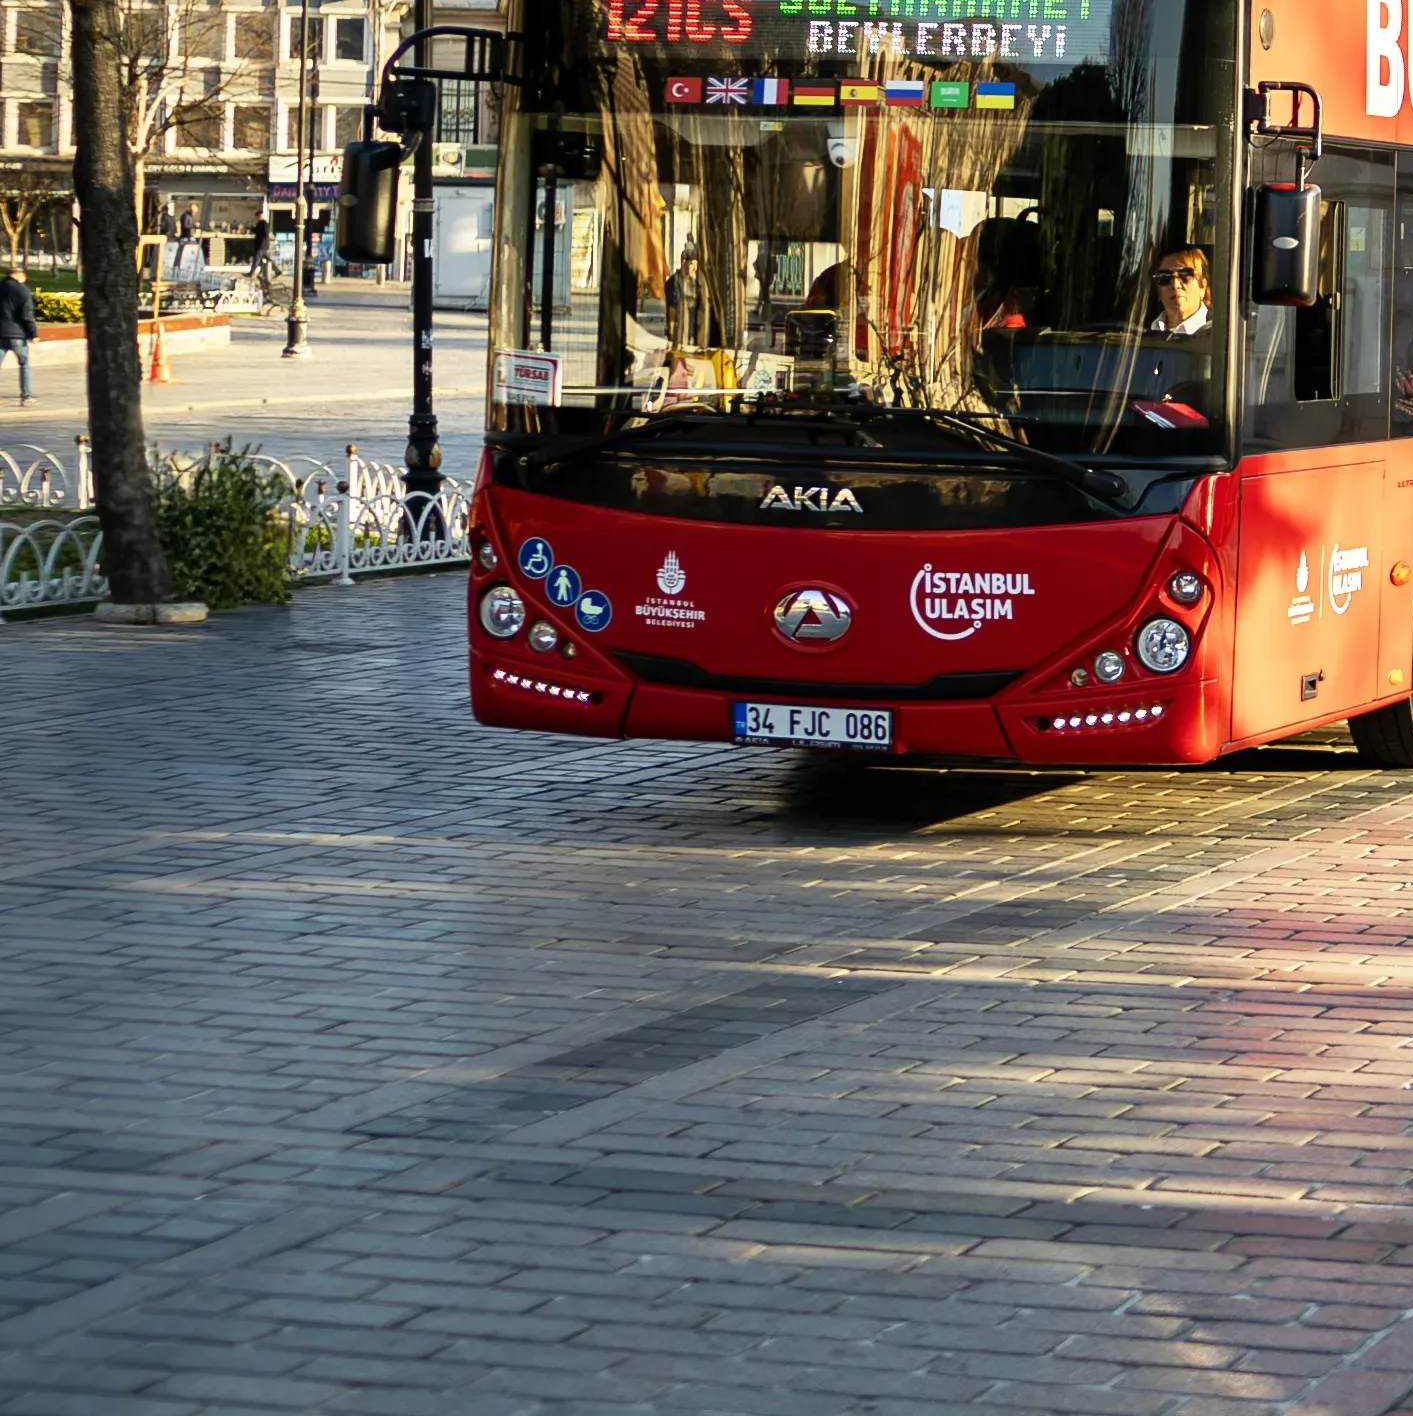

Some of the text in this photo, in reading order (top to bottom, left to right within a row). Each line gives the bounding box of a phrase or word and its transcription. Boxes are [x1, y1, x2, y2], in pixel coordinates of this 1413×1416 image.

[760, 485, 864, 513] AKIA
[924, 563, 1036, 595] İSTANBUL
[748, 706, 887, 741] 34 FJC 086
